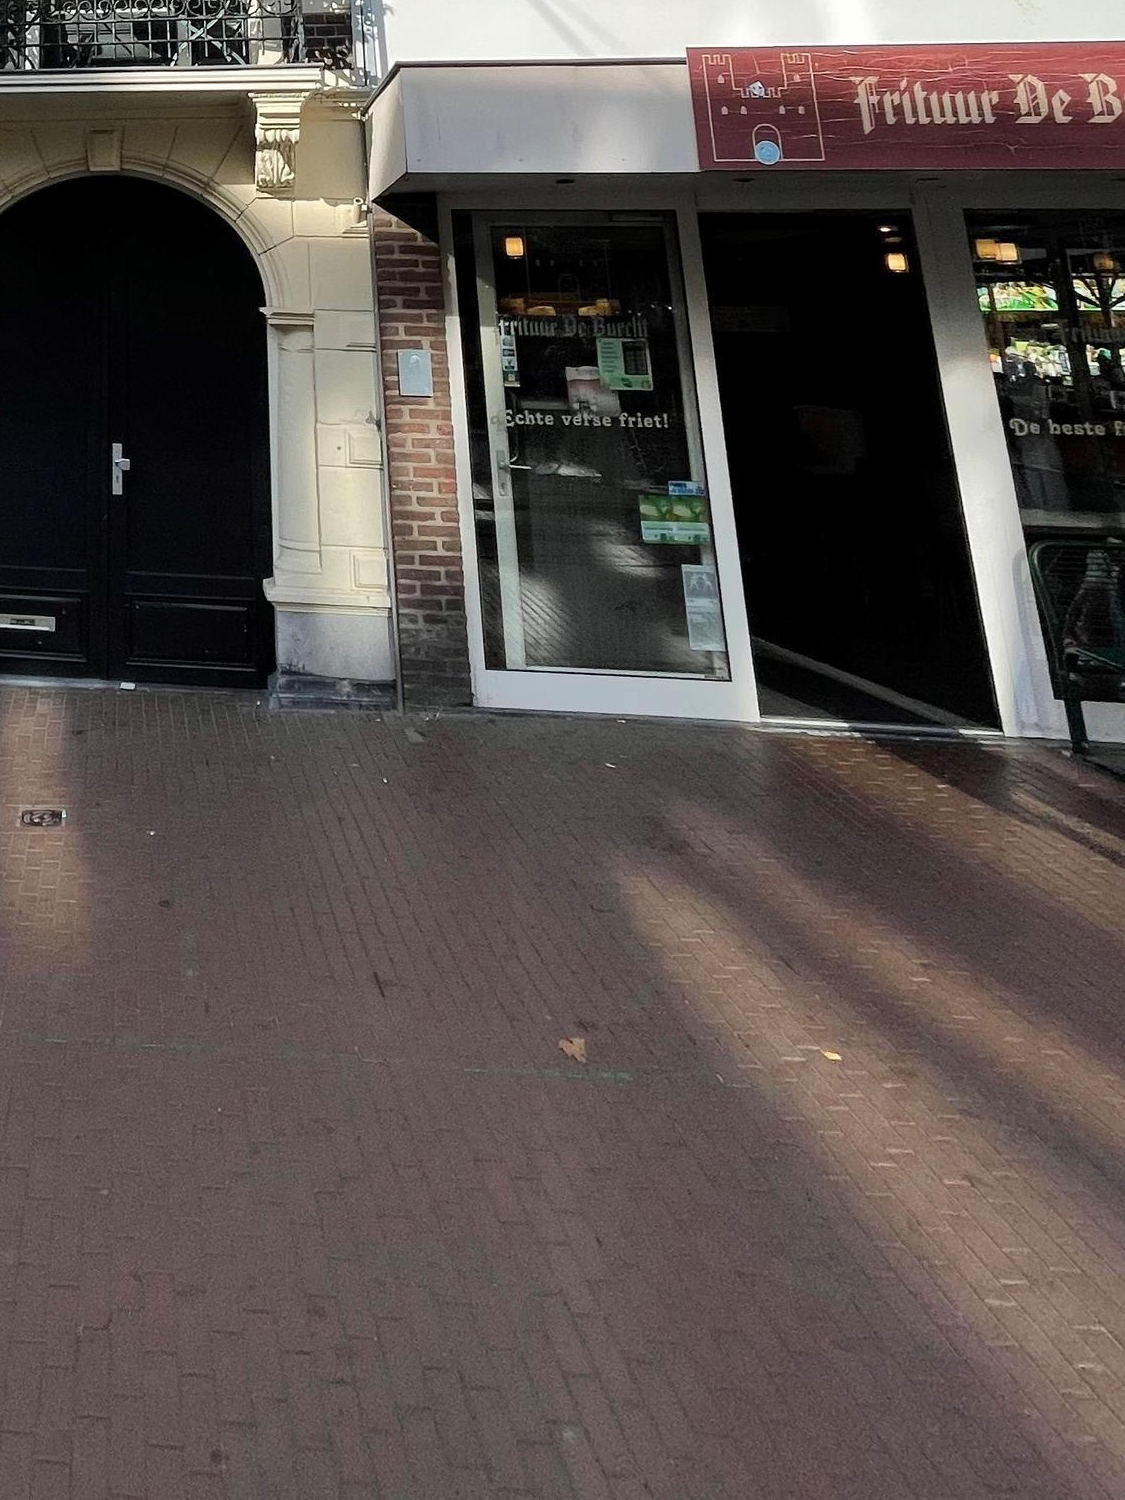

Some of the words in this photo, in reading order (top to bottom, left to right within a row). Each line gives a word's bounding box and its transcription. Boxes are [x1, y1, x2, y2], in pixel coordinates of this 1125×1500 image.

[849, 76, 999, 135] Frituur
[1007, 74, 1073, 124] De
[505, 409, 554, 427] Echte
[561, 411, 612, 427] verse
[619, 412, 670, 429] friet!
[1009, 418, 1040, 436] De
[1048, 418, 1106, 436] beste
